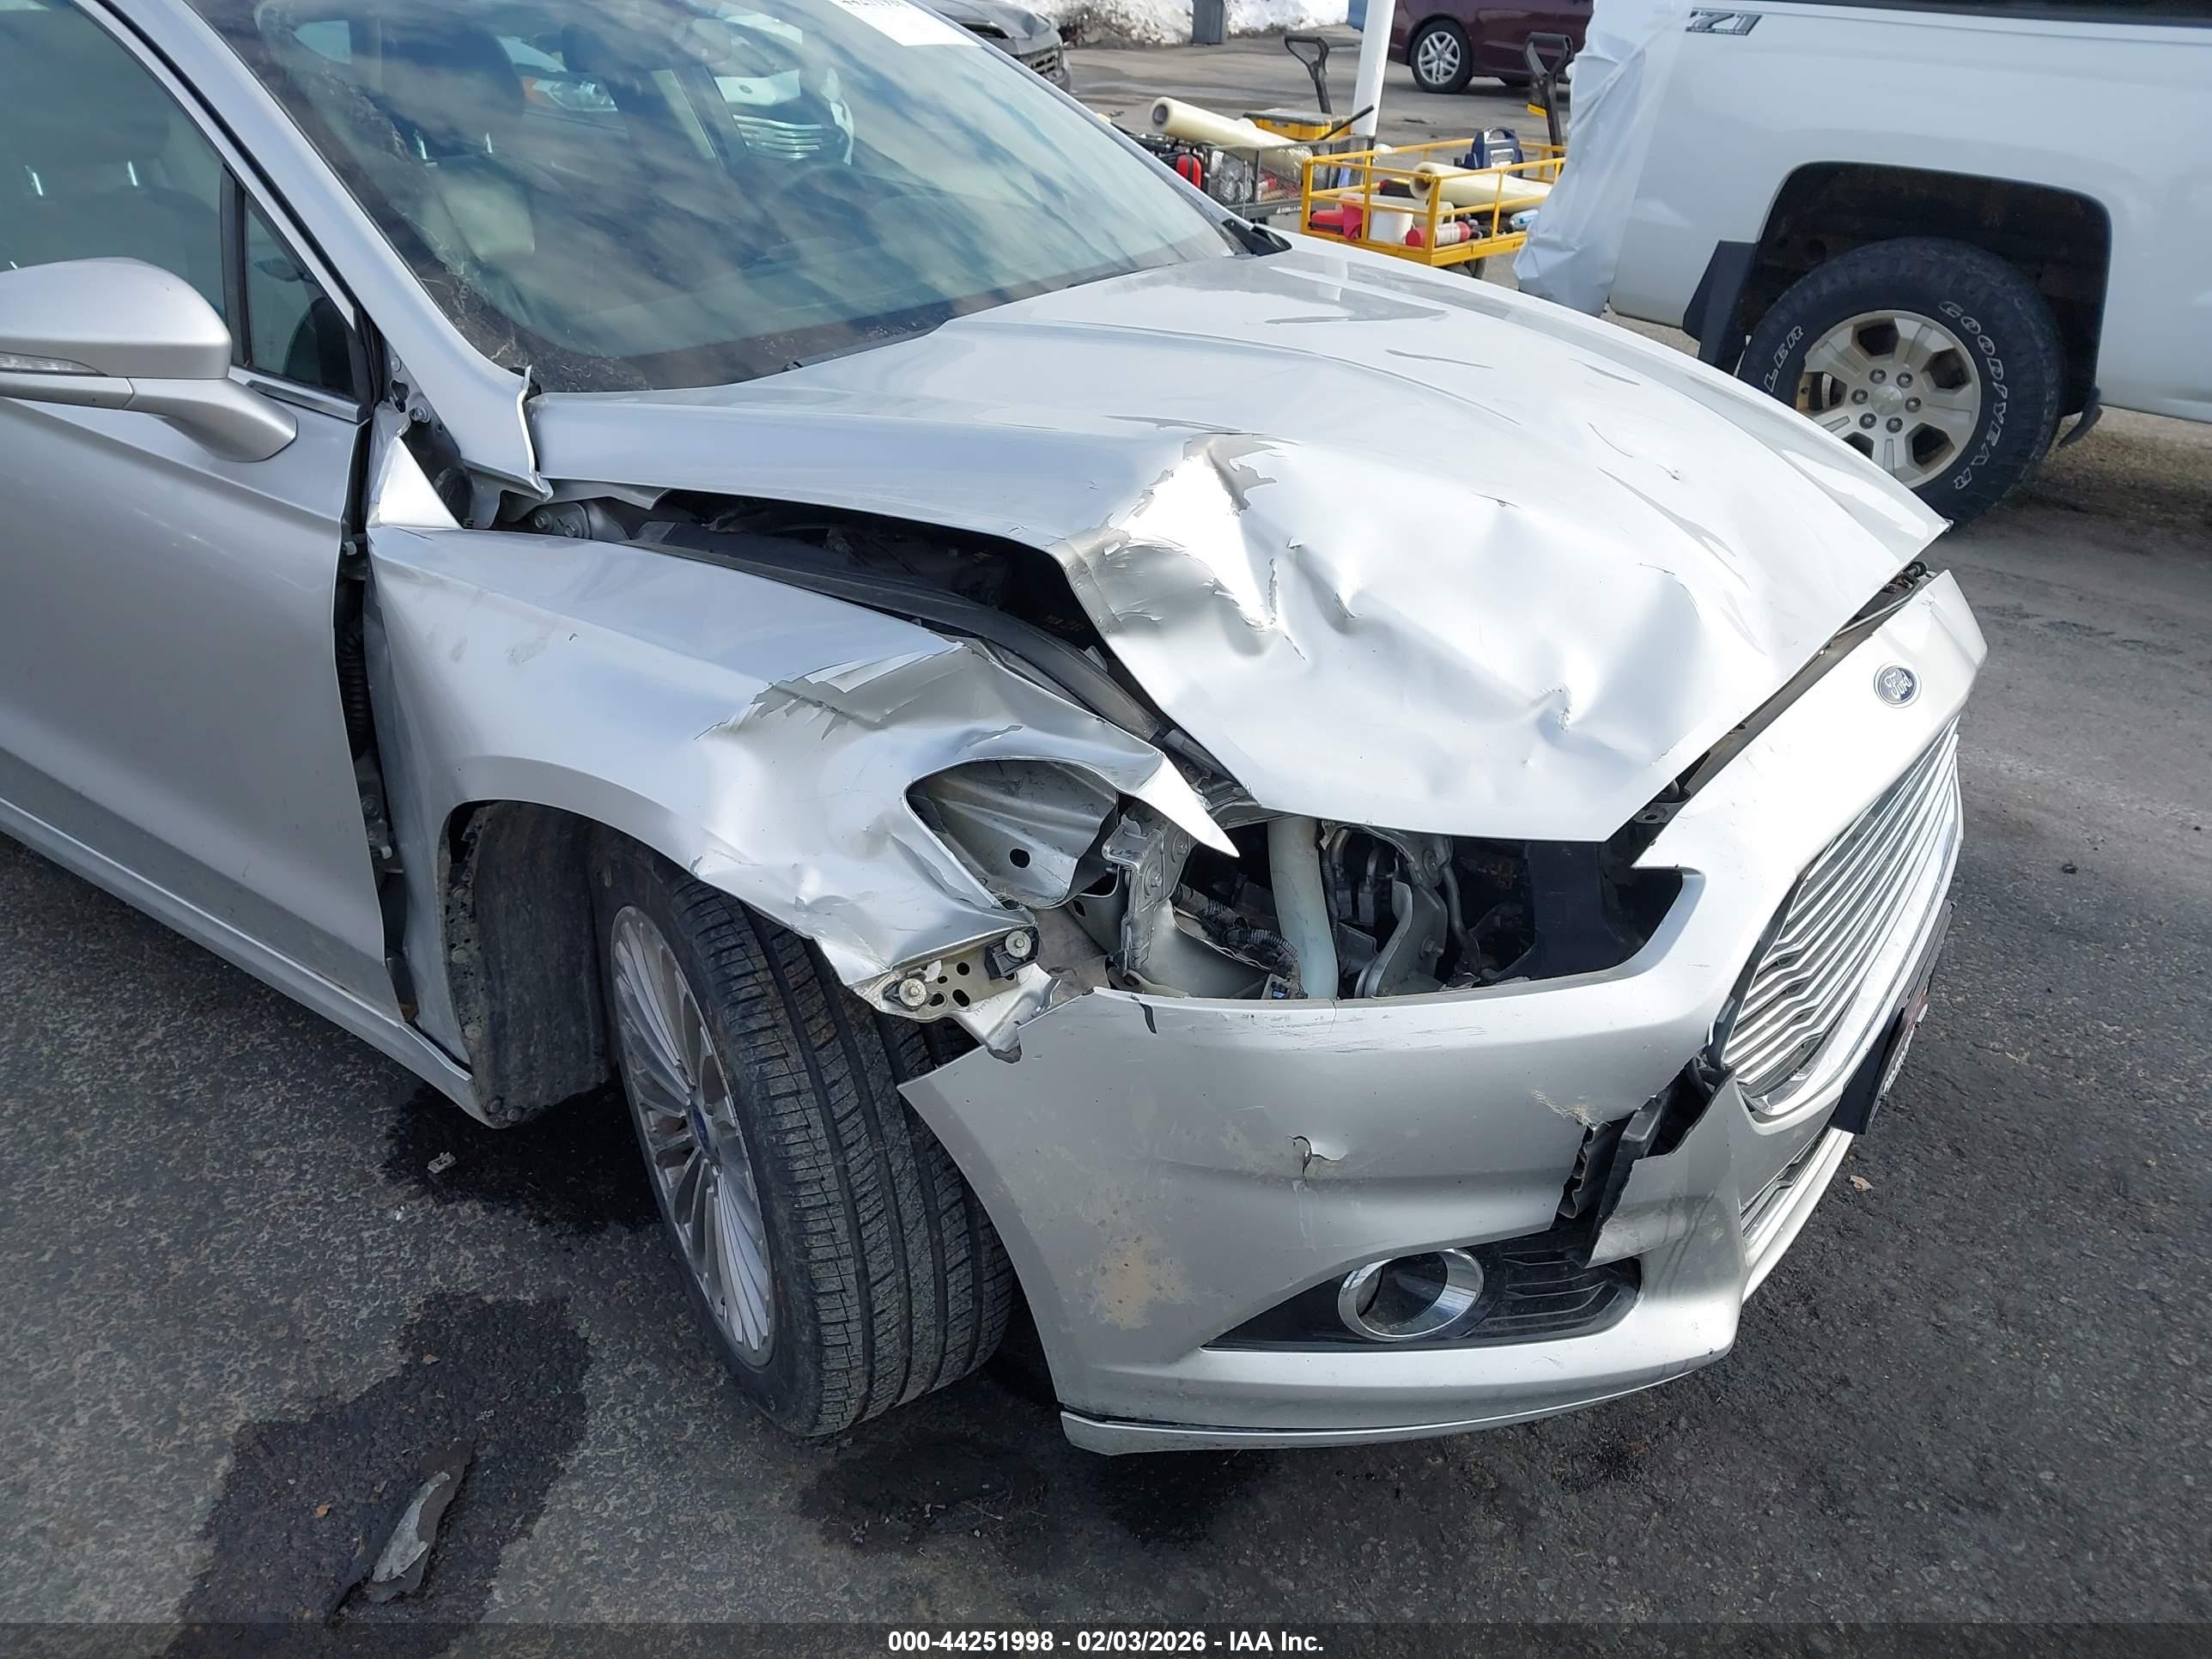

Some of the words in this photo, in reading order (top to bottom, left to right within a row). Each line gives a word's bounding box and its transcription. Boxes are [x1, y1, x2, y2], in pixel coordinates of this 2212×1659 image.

[1687, 10, 1763, 34] 71
[1764, 325, 1803, 393] LER
[1938, 301, 2008, 490] GOODYEAR
[1883, 671, 1914, 700] Ford
